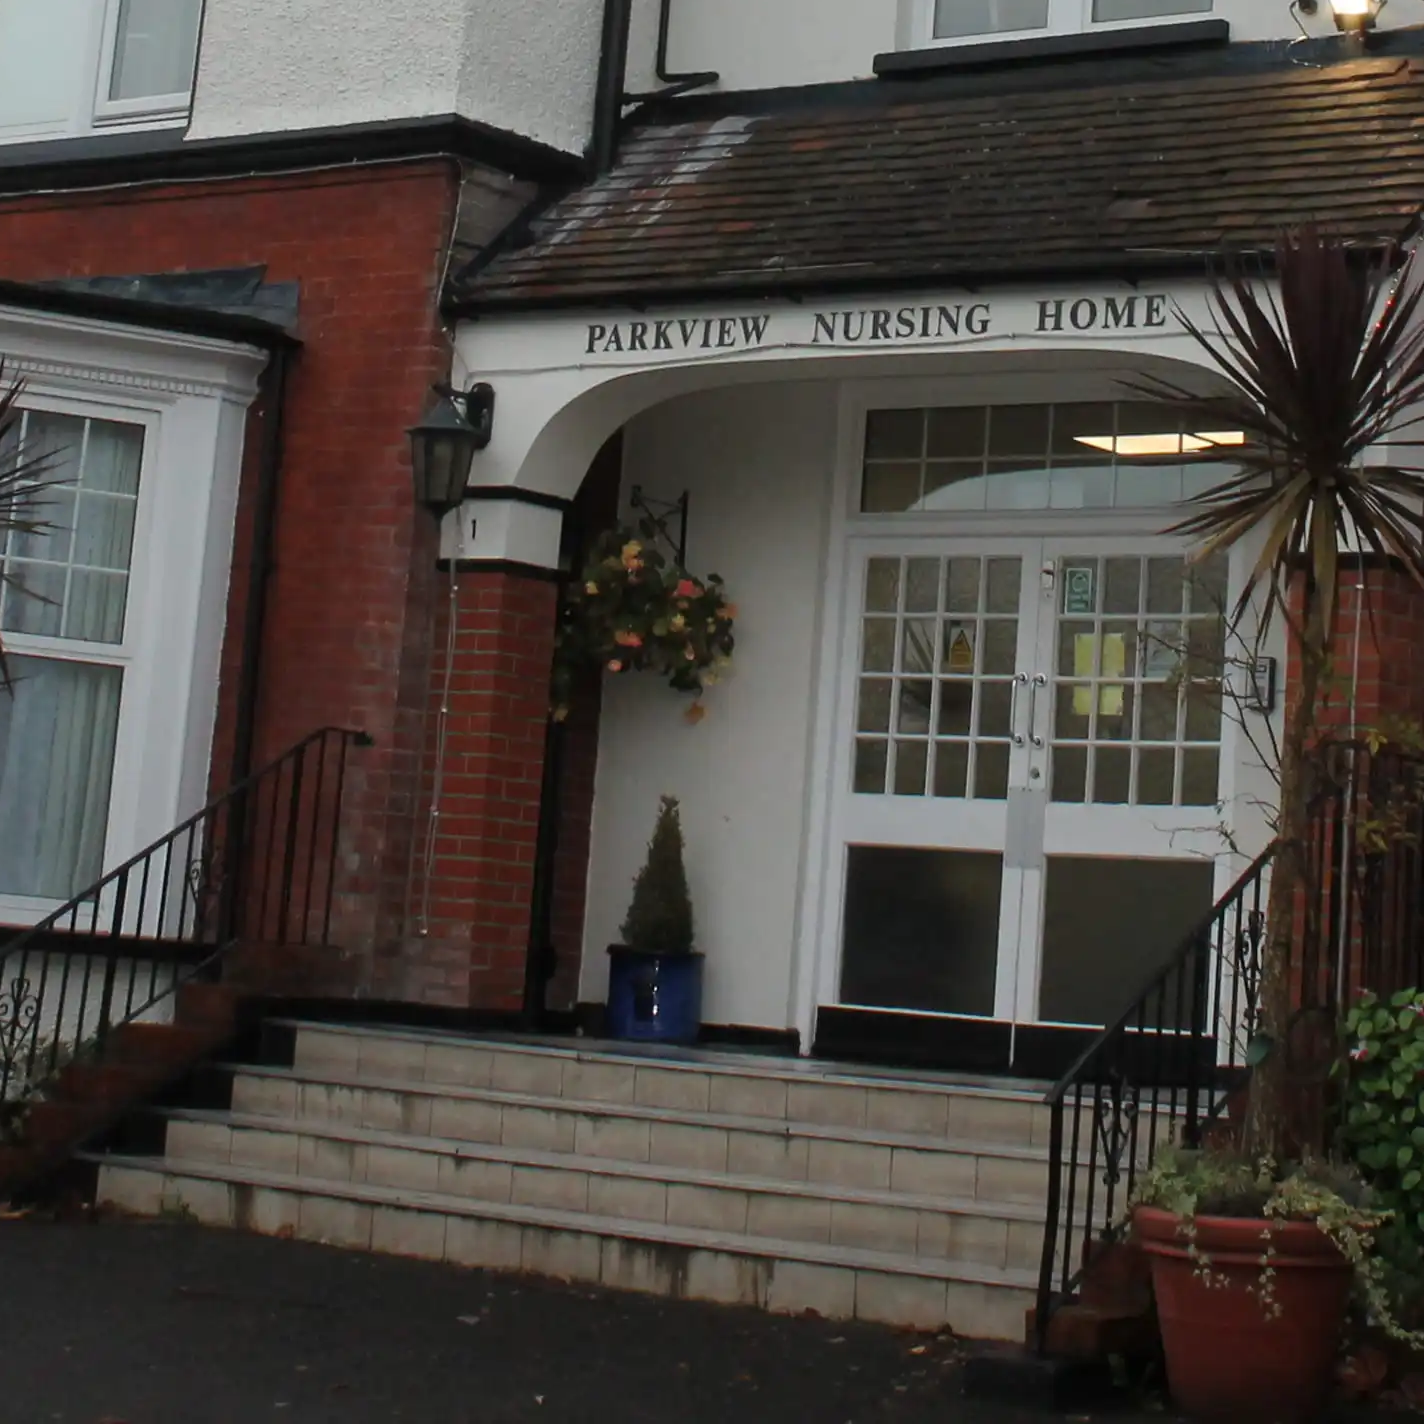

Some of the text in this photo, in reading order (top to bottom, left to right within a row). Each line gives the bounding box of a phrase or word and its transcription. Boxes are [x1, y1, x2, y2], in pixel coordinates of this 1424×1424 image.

[585, 294, 1166, 353] PARKVIEW NURSING HOME
